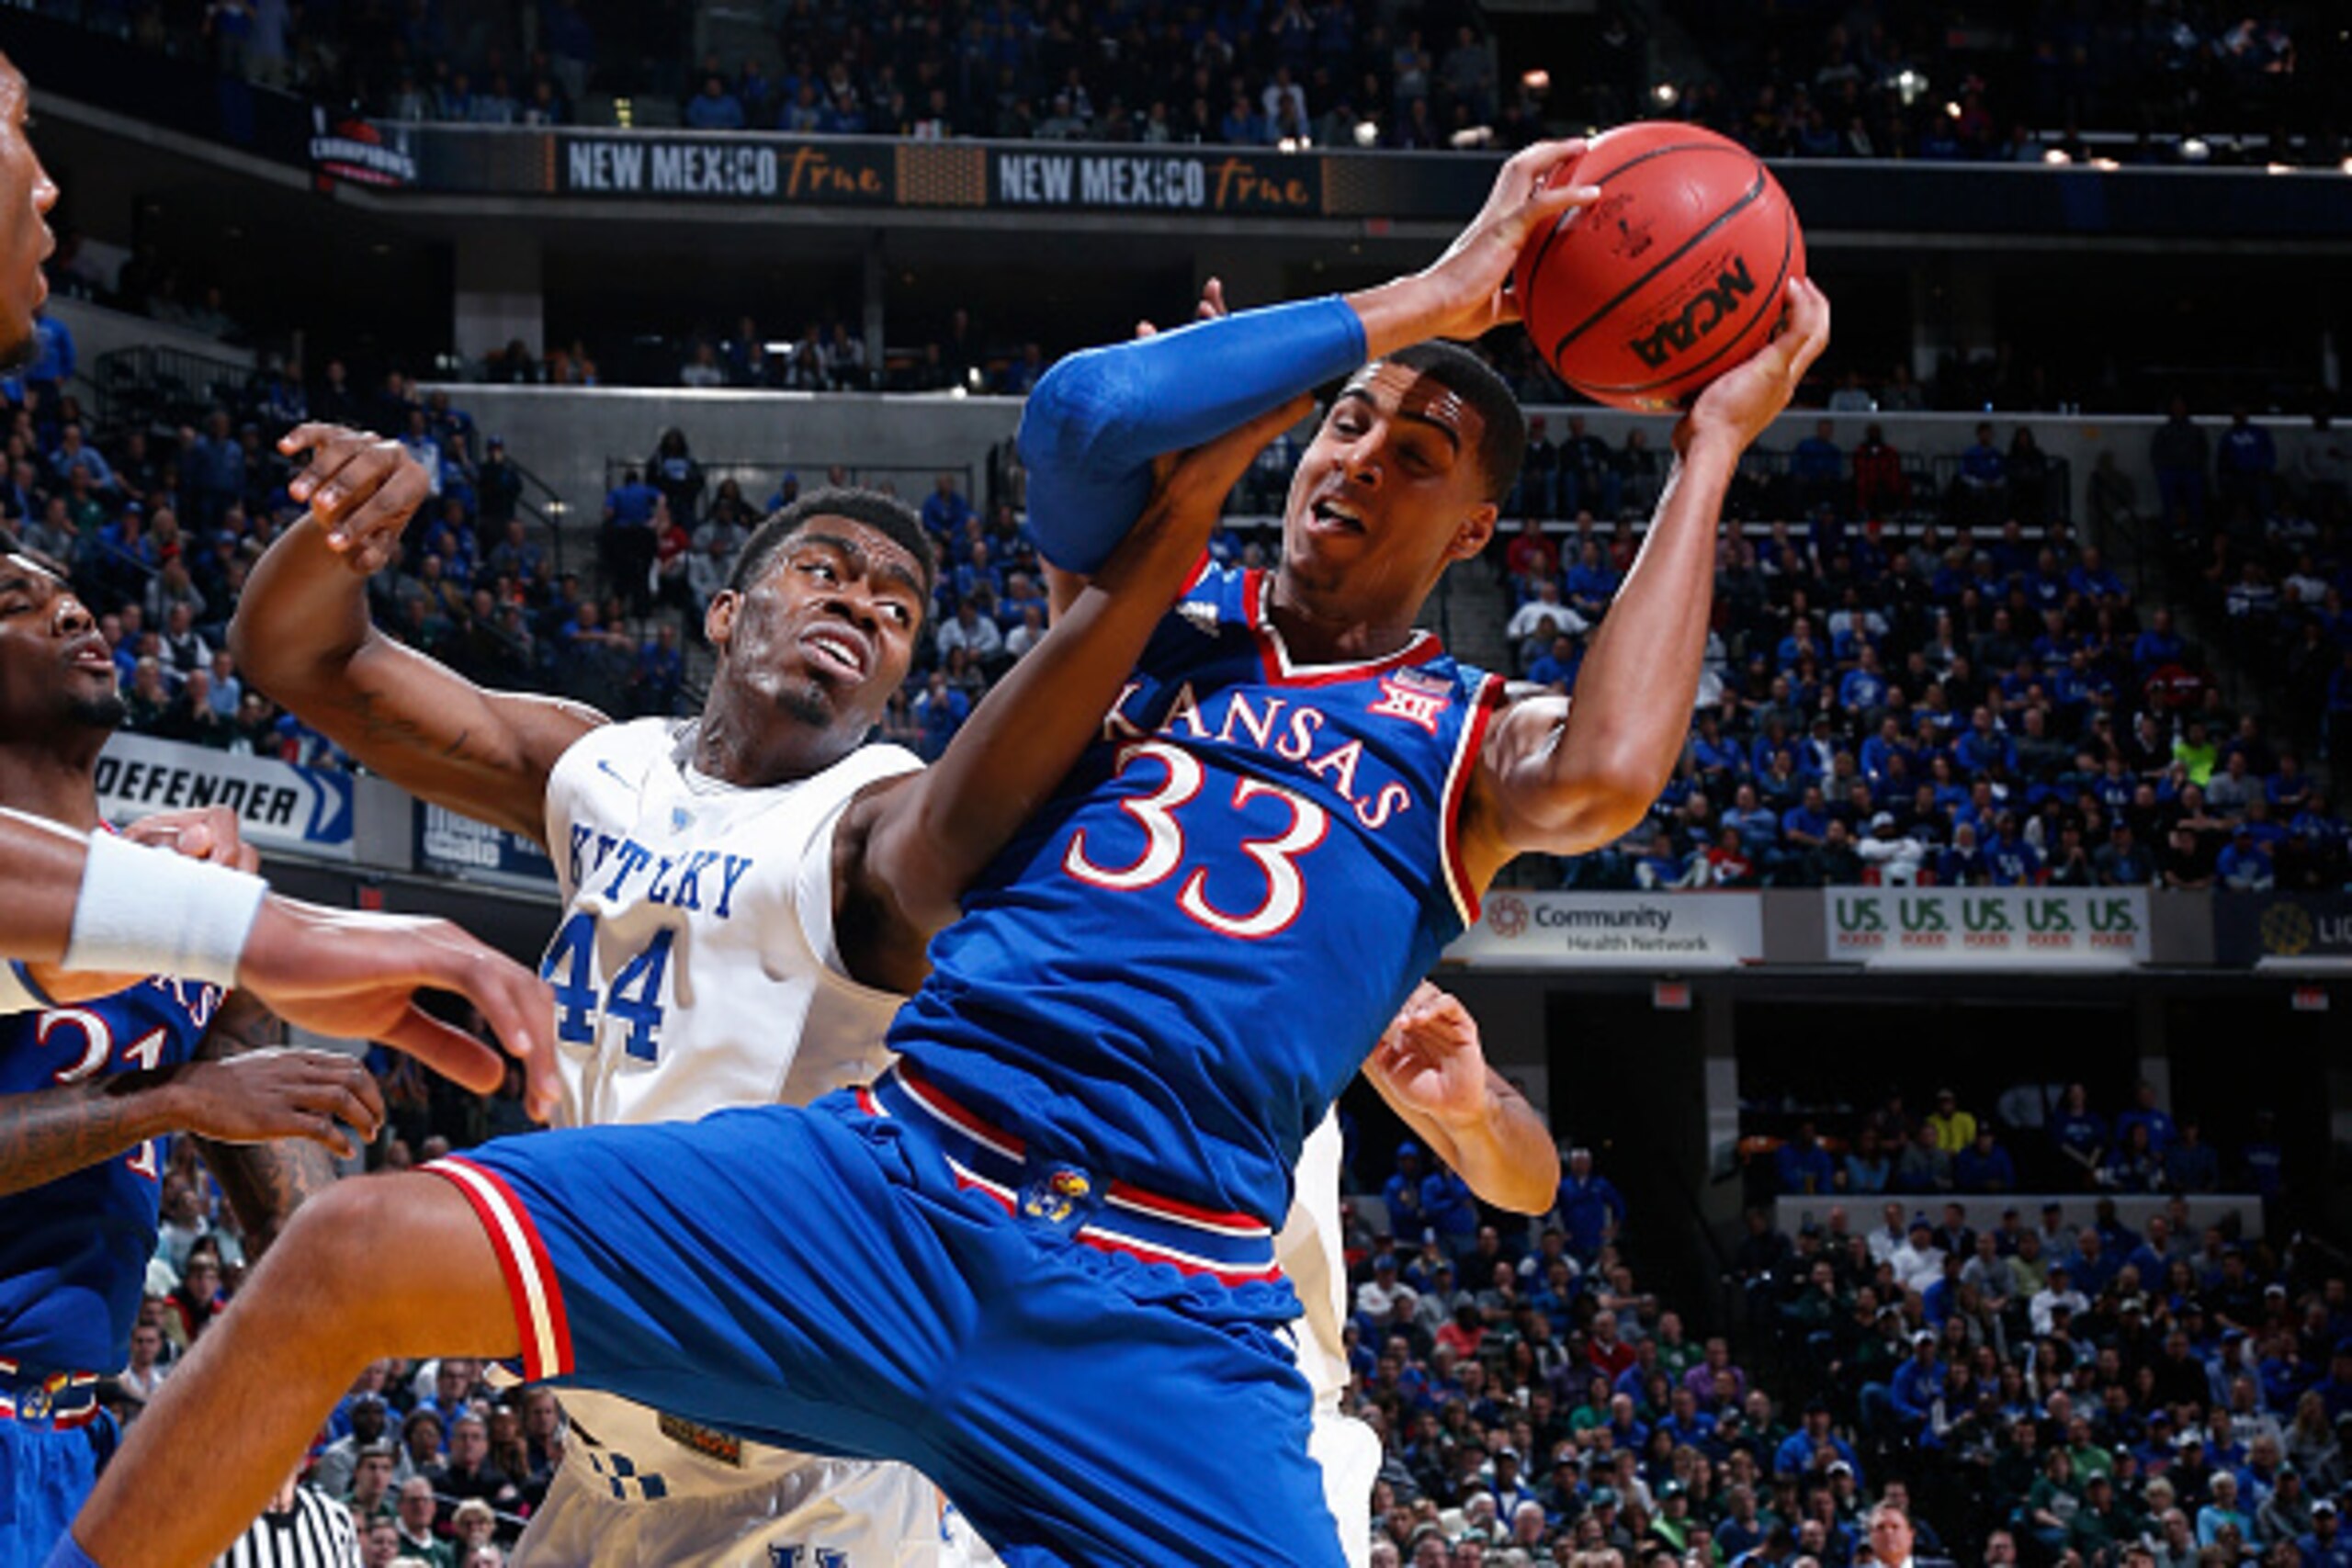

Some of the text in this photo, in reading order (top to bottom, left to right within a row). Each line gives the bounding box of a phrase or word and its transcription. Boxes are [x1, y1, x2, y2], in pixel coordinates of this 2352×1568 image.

[569, 141, 643, 190] NEW
[1000, 153, 1074, 202] NEW
[1630, 255, 1757, 369] NCAA
[1102, 680, 1411, 830] KANSAS
[95, 756, 298, 826] DEFENDER
[1061, 737, 1331, 942] 33
[1534, 904, 1672, 933] Community
[1567, 935, 1709, 952] Health Network
[540, 912, 678, 1062] 44
